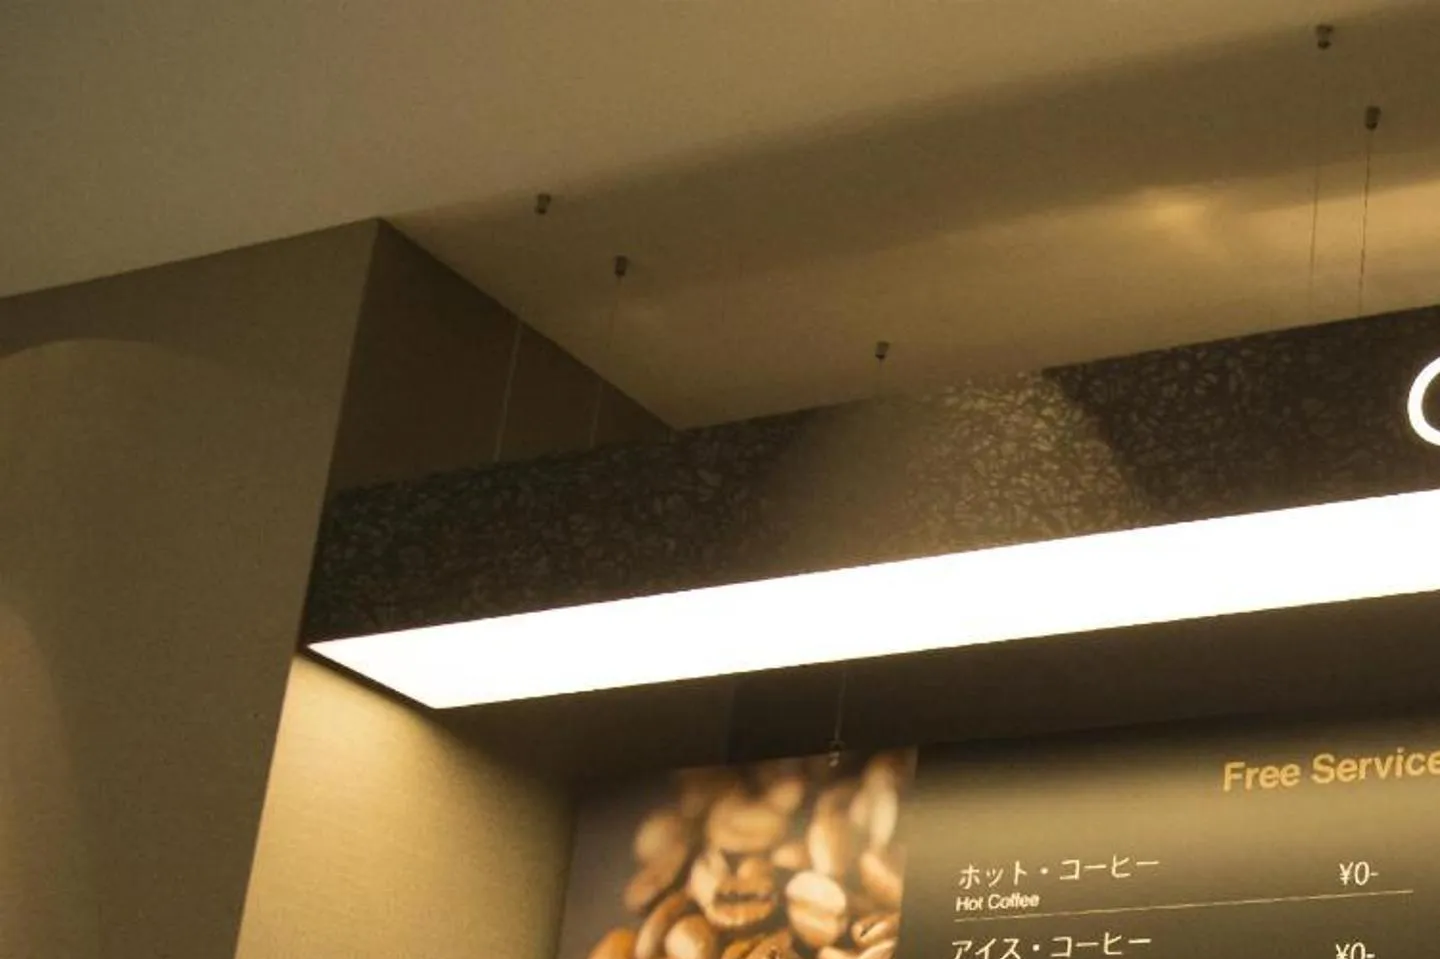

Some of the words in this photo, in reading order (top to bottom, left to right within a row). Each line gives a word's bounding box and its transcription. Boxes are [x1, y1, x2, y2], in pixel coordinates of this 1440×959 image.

[1223, 761, 1302, 792] Free
[955, 896, 984, 912] Hot
[987, 891, 1040, 911] Coffee
